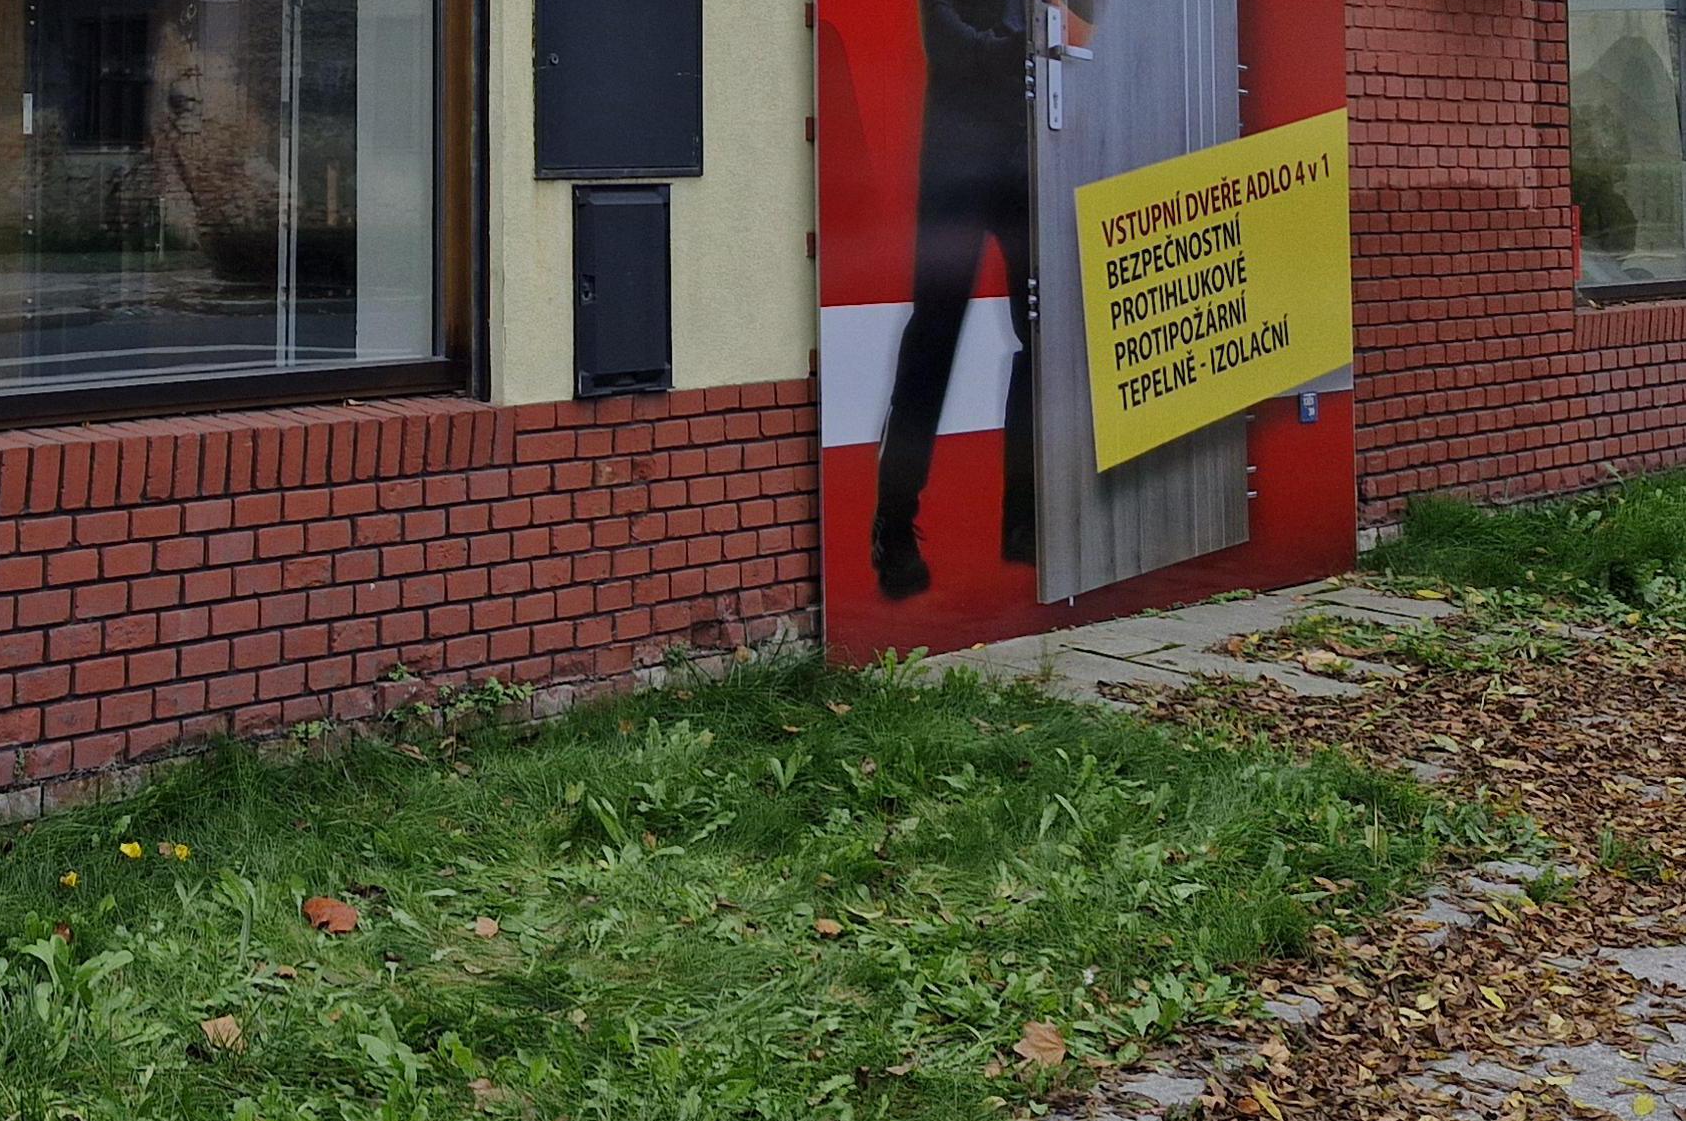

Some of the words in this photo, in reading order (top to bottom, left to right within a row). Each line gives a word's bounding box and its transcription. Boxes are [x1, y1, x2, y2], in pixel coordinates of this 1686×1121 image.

[1102, 191, 1182, 248] VSTUPNÍ
[1186, 176, 1242, 223] DVEŘE
[1246, 164, 1292, 204] ADLO
[1295, 159, 1306, 186] 4
[1308, 161, 1318, 182] v
[1321, 152, 1330, 178] 1
[1106, 212, 1242, 289] BEZPEČNOSTNÍ
[1110, 251, 1248, 330] PROTIHLUKOVÉ
[1114, 290, 1248, 371] PROTIPOŽÁRNÍ
[1118, 350, 1197, 411] TEPELNĚ
[1209, 314, 1291, 376] IZOLAČNÍ
